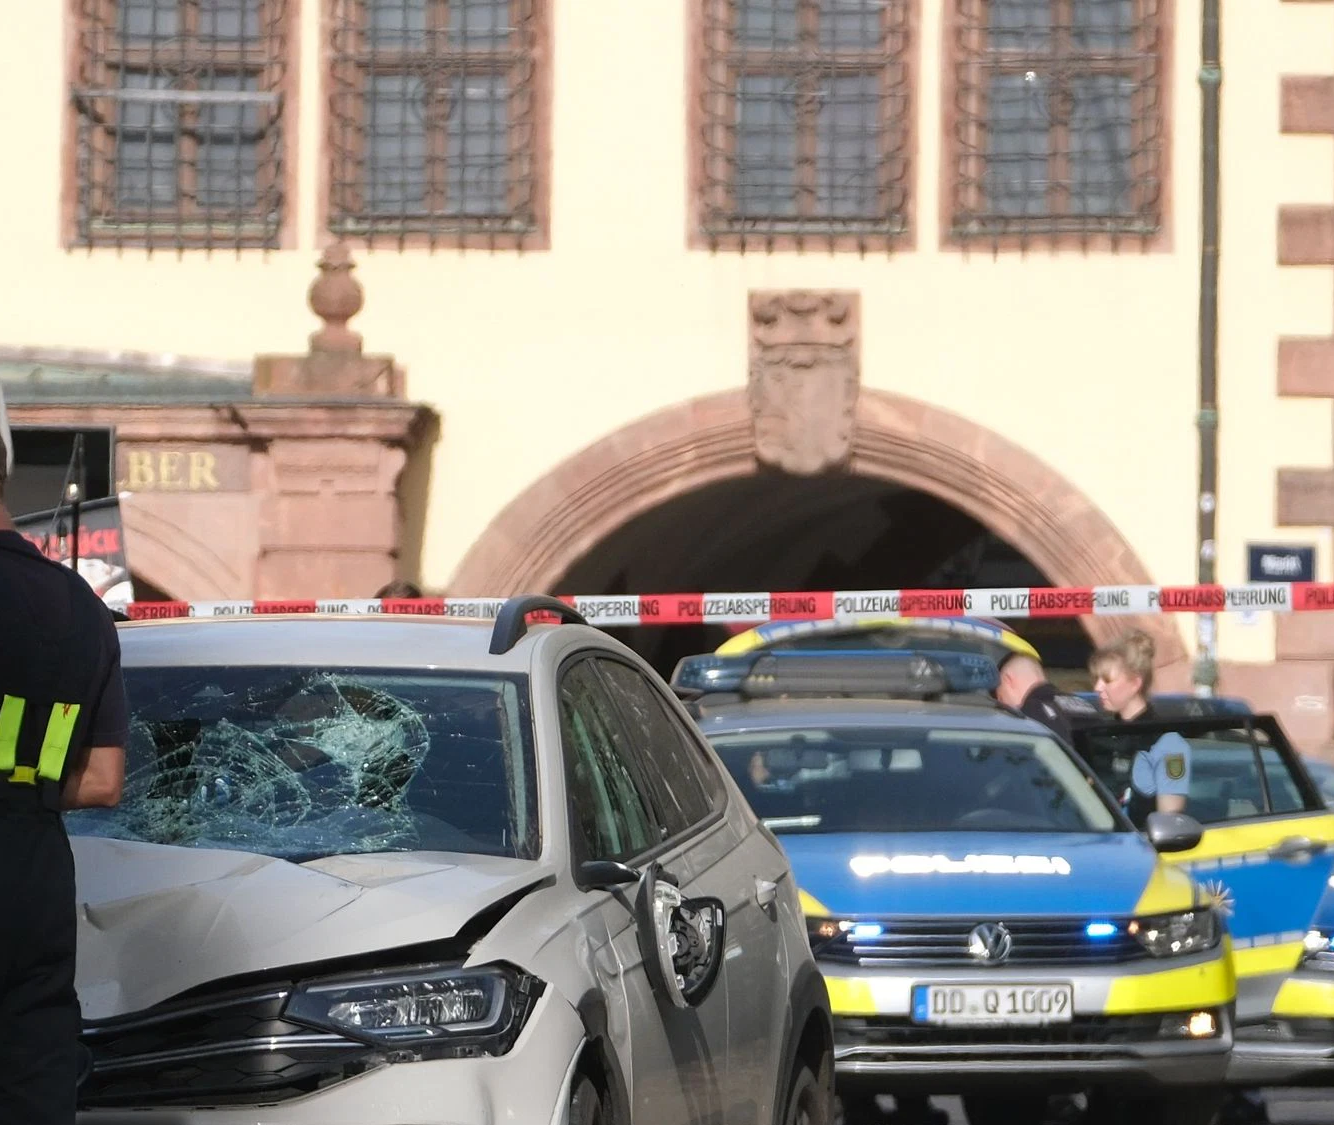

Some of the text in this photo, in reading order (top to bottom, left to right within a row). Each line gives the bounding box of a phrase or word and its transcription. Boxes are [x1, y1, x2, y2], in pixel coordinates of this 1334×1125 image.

[117, 450, 220, 490] BER
[677, 596, 817, 617] POLIZEIABSPERRUNG
[835, 593, 973, 614] POLIZEIABSPERRUNG
[990, 589, 1130, 611] POLIZEIABSPERRUNG
[1147, 586, 1287, 609] POLIZEIABSPERRUNG
[932, 988, 1068, 1015] DD Q 1009
